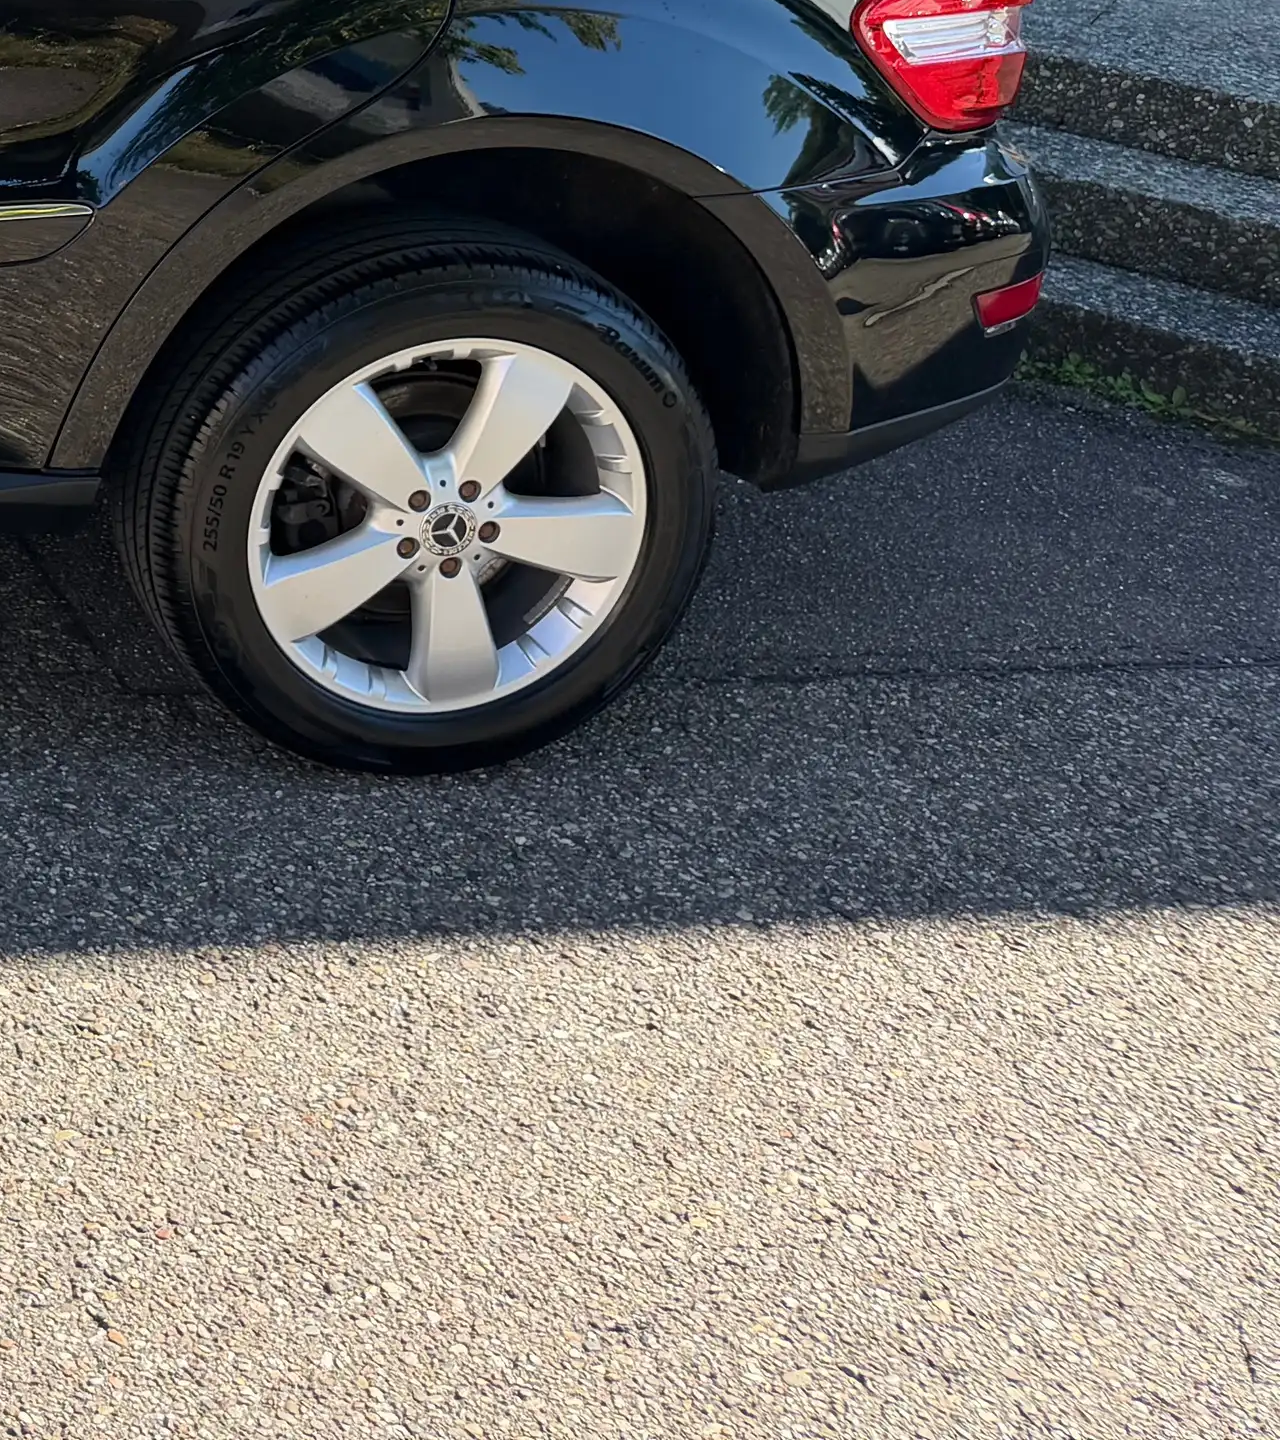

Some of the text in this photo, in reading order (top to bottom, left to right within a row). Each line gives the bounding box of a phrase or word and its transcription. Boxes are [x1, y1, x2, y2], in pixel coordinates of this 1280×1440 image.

[226, 440, 247, 462] 19
[217, 463, 237, 481] R
[202, 484, 229, 553] 255/50
